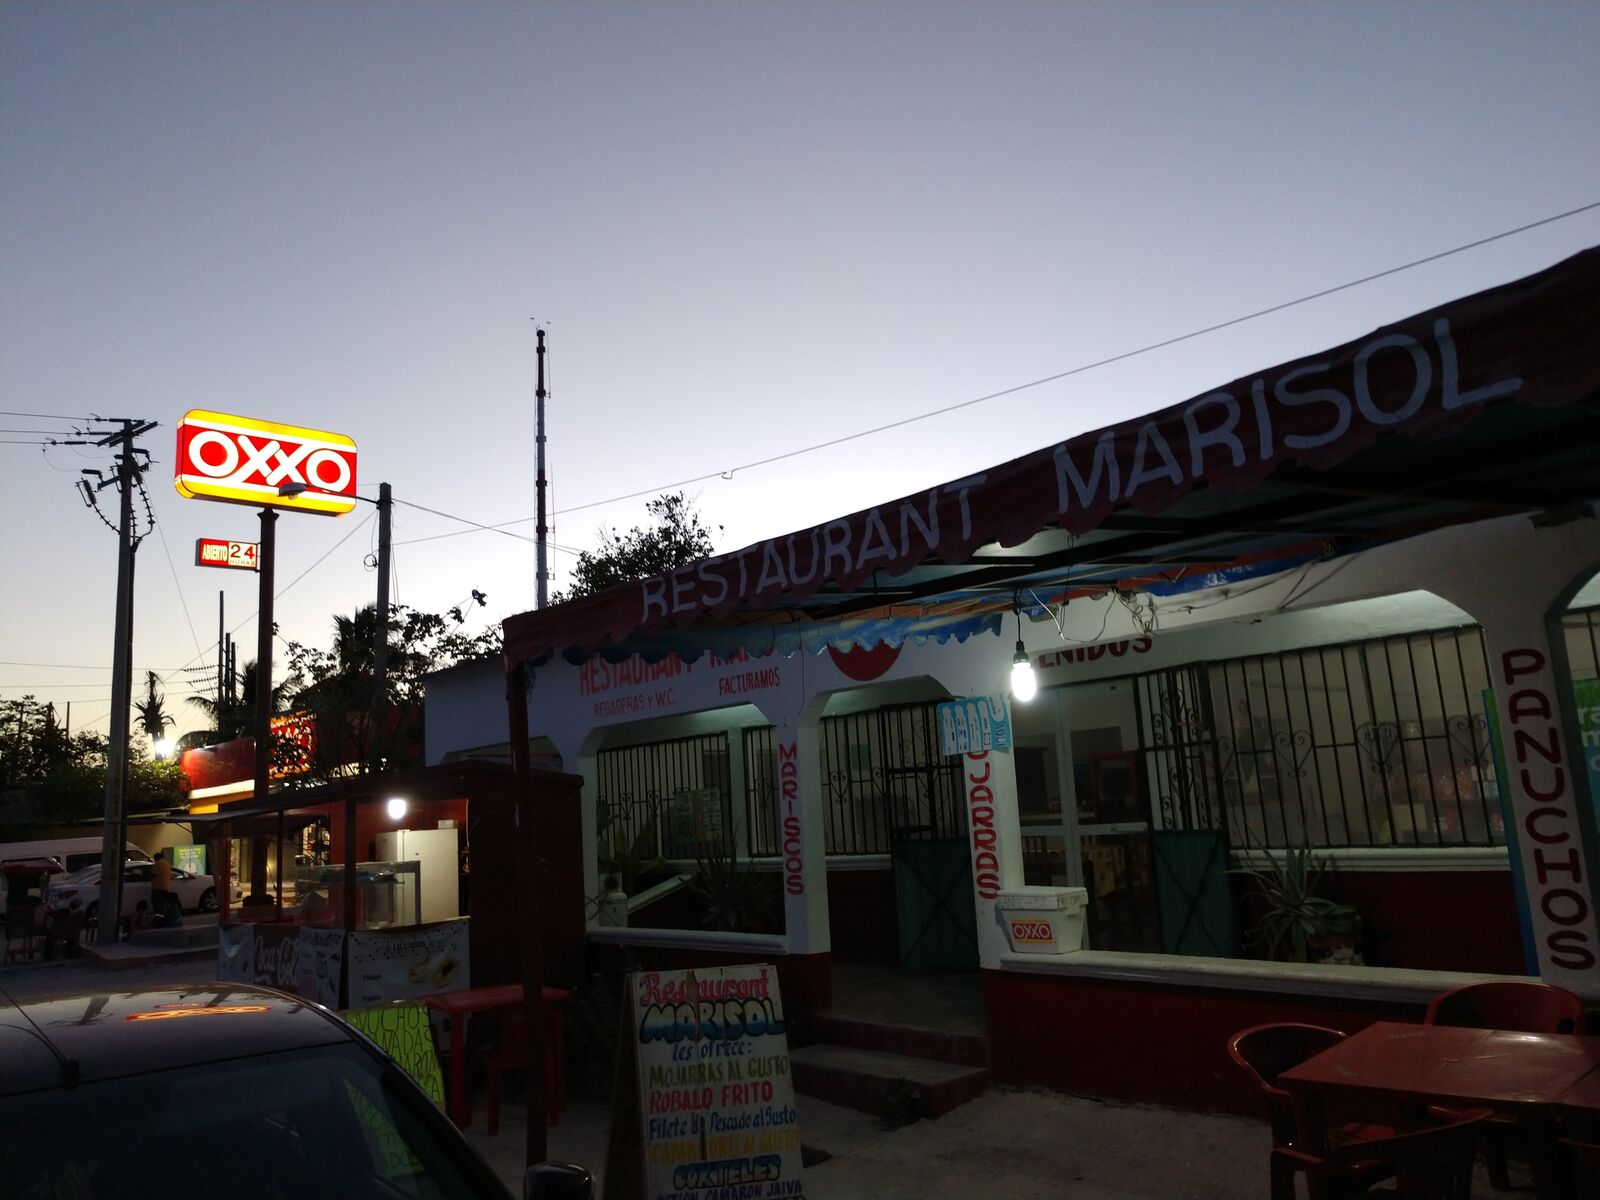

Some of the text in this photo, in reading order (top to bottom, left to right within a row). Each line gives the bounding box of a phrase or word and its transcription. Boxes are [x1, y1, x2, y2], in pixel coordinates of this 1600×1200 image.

[189, 431, 351, 493] OXXO
[641, 317, 1524, 623] RESTAURANT MARISOL
[202, 544, 256, 562] ABIERTO 24
[719, 667, 781, 696] FACTURAMOS
[594, 694, 644, 720] REGADERAS
[779, 742, 804, 895] MARISCOS
[967, 752, 1001, 900] JARRAS
[1502, 649, 1596, 970] PANUCHOS
[1014, 924, 1051, 940] OXXO
[640, 997, 785, 1043] MARISOL
[649, 1055, 788, 1089] MOJARRAS AL GUSTO
[650, 1081, 773, 1114] ROBALO FRITO
[650, 1116, 688, 1140] Filete
[673, 1154, 781, 1190] COKTELES
[767, 1178, 802, 1197] JAIVA
